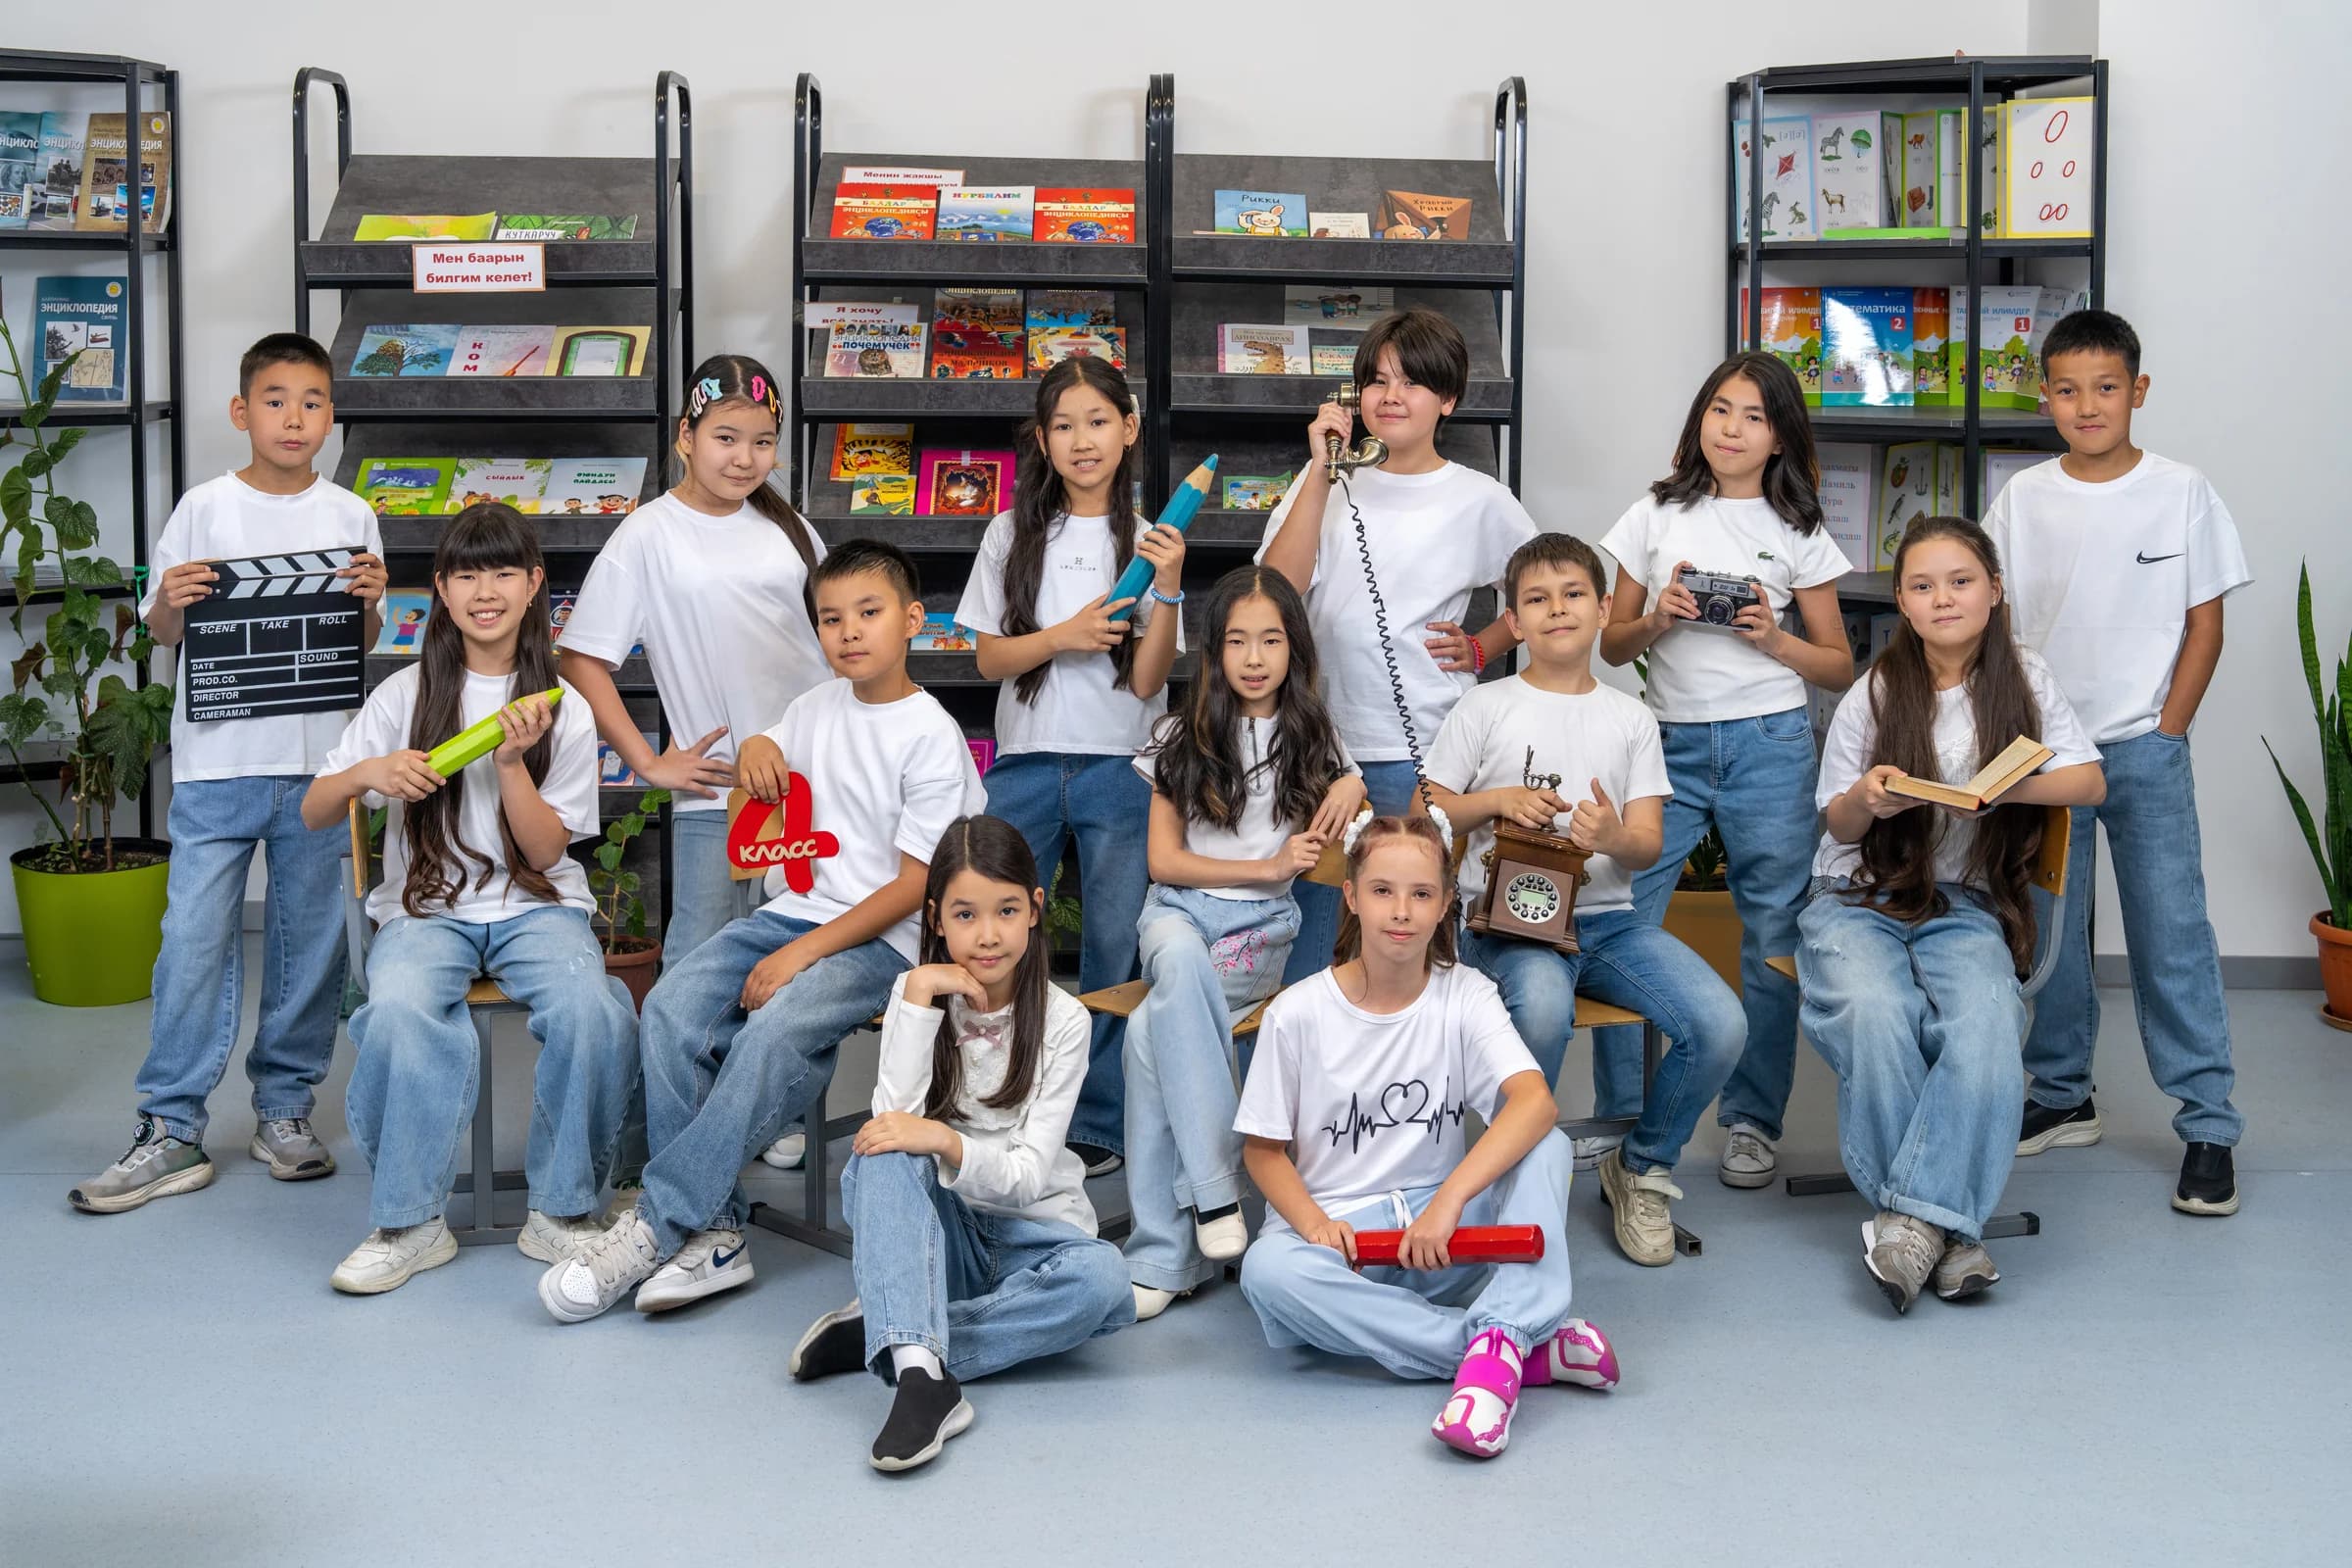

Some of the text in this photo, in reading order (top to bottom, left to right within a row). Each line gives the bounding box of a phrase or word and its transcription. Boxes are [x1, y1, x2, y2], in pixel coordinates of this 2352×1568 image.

[91, 139, 162, 151] ЭНЦИКЛЕДИЯ
[432, 252, 525, 266] Мен баарын
[425, 271, 533, 284] билгим келет!
[40, 303, 118, 315] ЭНЦИКЛОПЕДИЯ
[1851, 304, 1906, 314] тематика
[835, 323, 923, 335] БОЛЬШАЯ
[1813, 318, 1821, 329] 1
[1893, 318, 1902, 329] 2
[2018, 318, 2027, 330] 1
[842, 341, 910, 350] почемучек
[199, 614, 348, 635] SCENE TAKE ROLL
[299, 652, 339, 663] SOUND
[192, 662, 216, 671] DATE
[192, 674, 238, 686] PROD.CO.
[193, 691, 239, 703] DIRECTOR
[194, 708, 252, 720] CAMERAMAN
